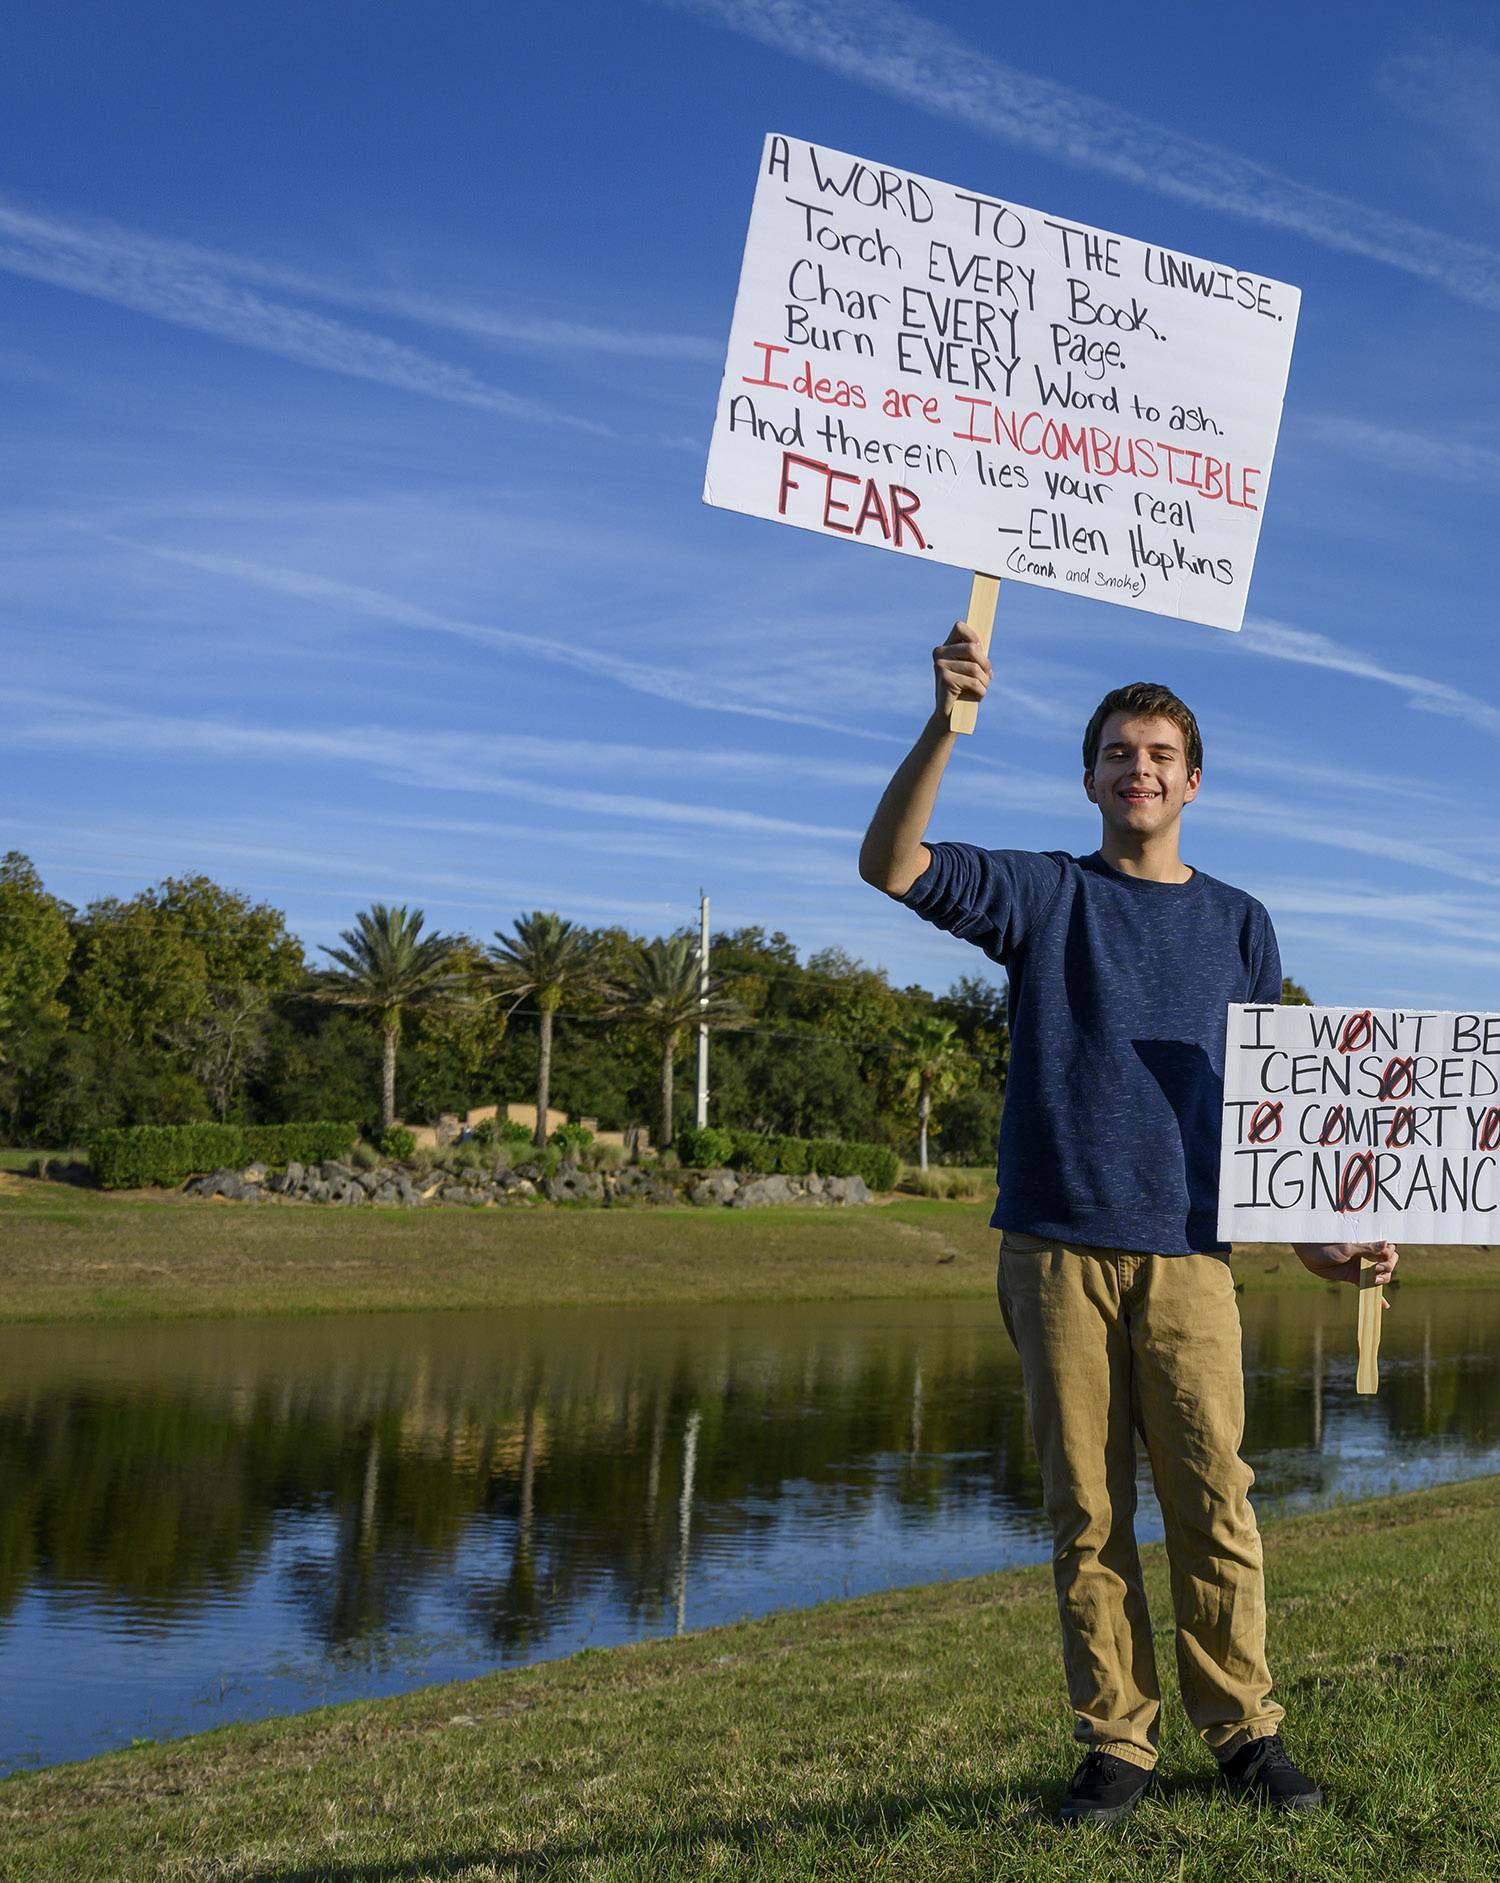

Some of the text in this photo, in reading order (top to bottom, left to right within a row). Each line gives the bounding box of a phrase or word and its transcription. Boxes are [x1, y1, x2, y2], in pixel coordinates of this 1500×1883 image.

[769, 136, 1282, 321] A WORD TO THE UNWISE.
[785, 196, 1167, 341] Torch EVERY Book.
[785, 304, 1224, 435] Burn EVERY Word to ash.
[789, 259, 1126, 380] Char EVERY Page.
[730, 395, 1195, 534] And therein lies your real
[742, 341, 1261, 511] Ideas are INCOMBUSTIBLE
[778, 451, 934, 550] FEAR.
[1129, 524, 1234, 585] Hopkins
[1066, 568, 1089, 585] and
[1240, 1008, 1275, 1049] I
[1260, 1051, 1498, 1102] CENSORED
